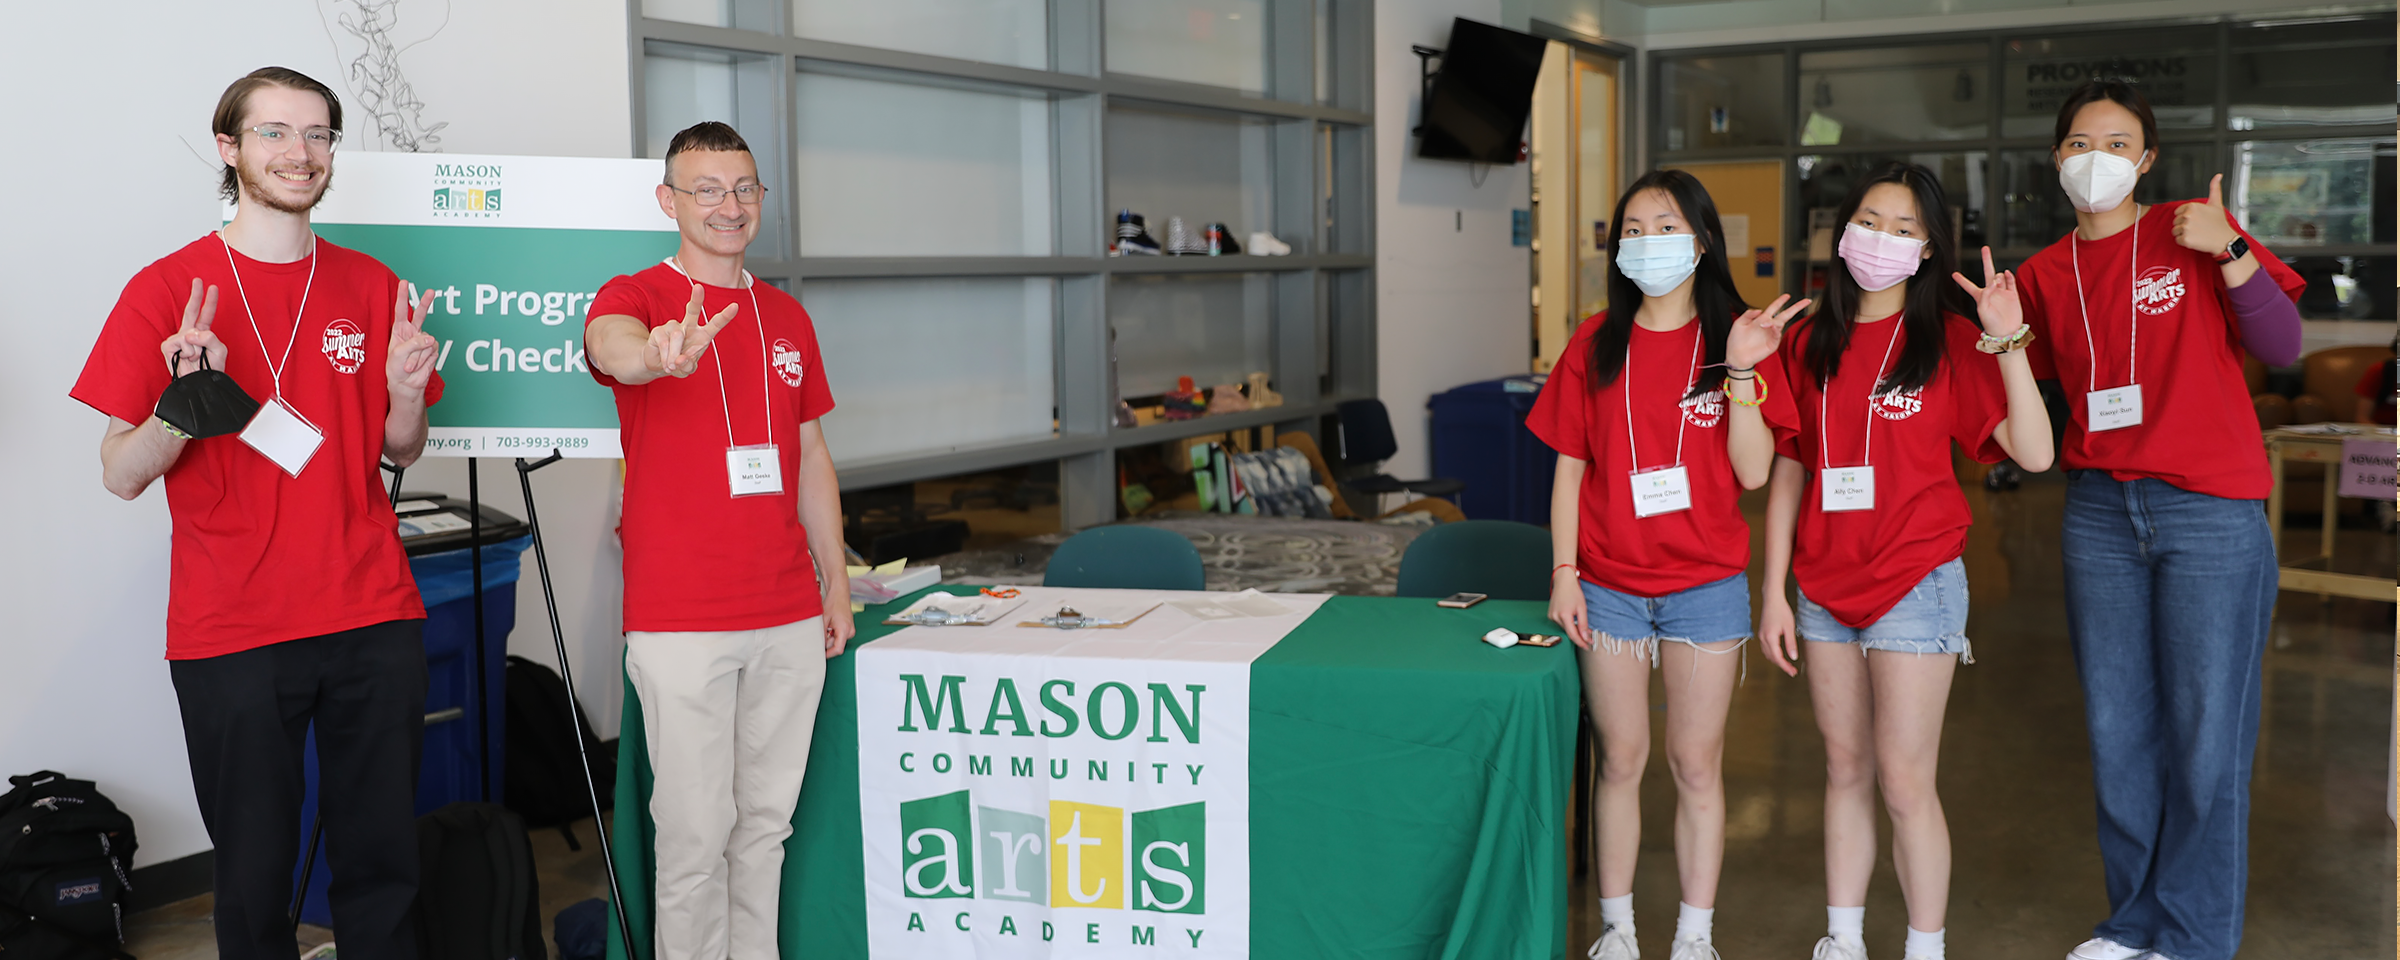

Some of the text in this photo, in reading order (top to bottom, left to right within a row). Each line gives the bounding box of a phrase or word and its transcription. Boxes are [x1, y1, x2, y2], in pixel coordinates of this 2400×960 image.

[2027, 57, 2187, 82] PROVONS
[434, 163, 502, 178] MASON
[433, 189, 501, 210] arts
[2147, 283, 2186, 304] ARTS
[336, 347, 365, 363] ARTS
[465, 339, 588, 372] Check
[1882, 394, 1923, 413] ARTS
[496, 437, 589, 448] 703-993-9889
[898, 673, 1206, 744] MASON
[899, 751, 1205, 786] COMMUNITY
[903, 808, 1196, 912] arts
[906, 911, 1205, 948] ACADEMY
